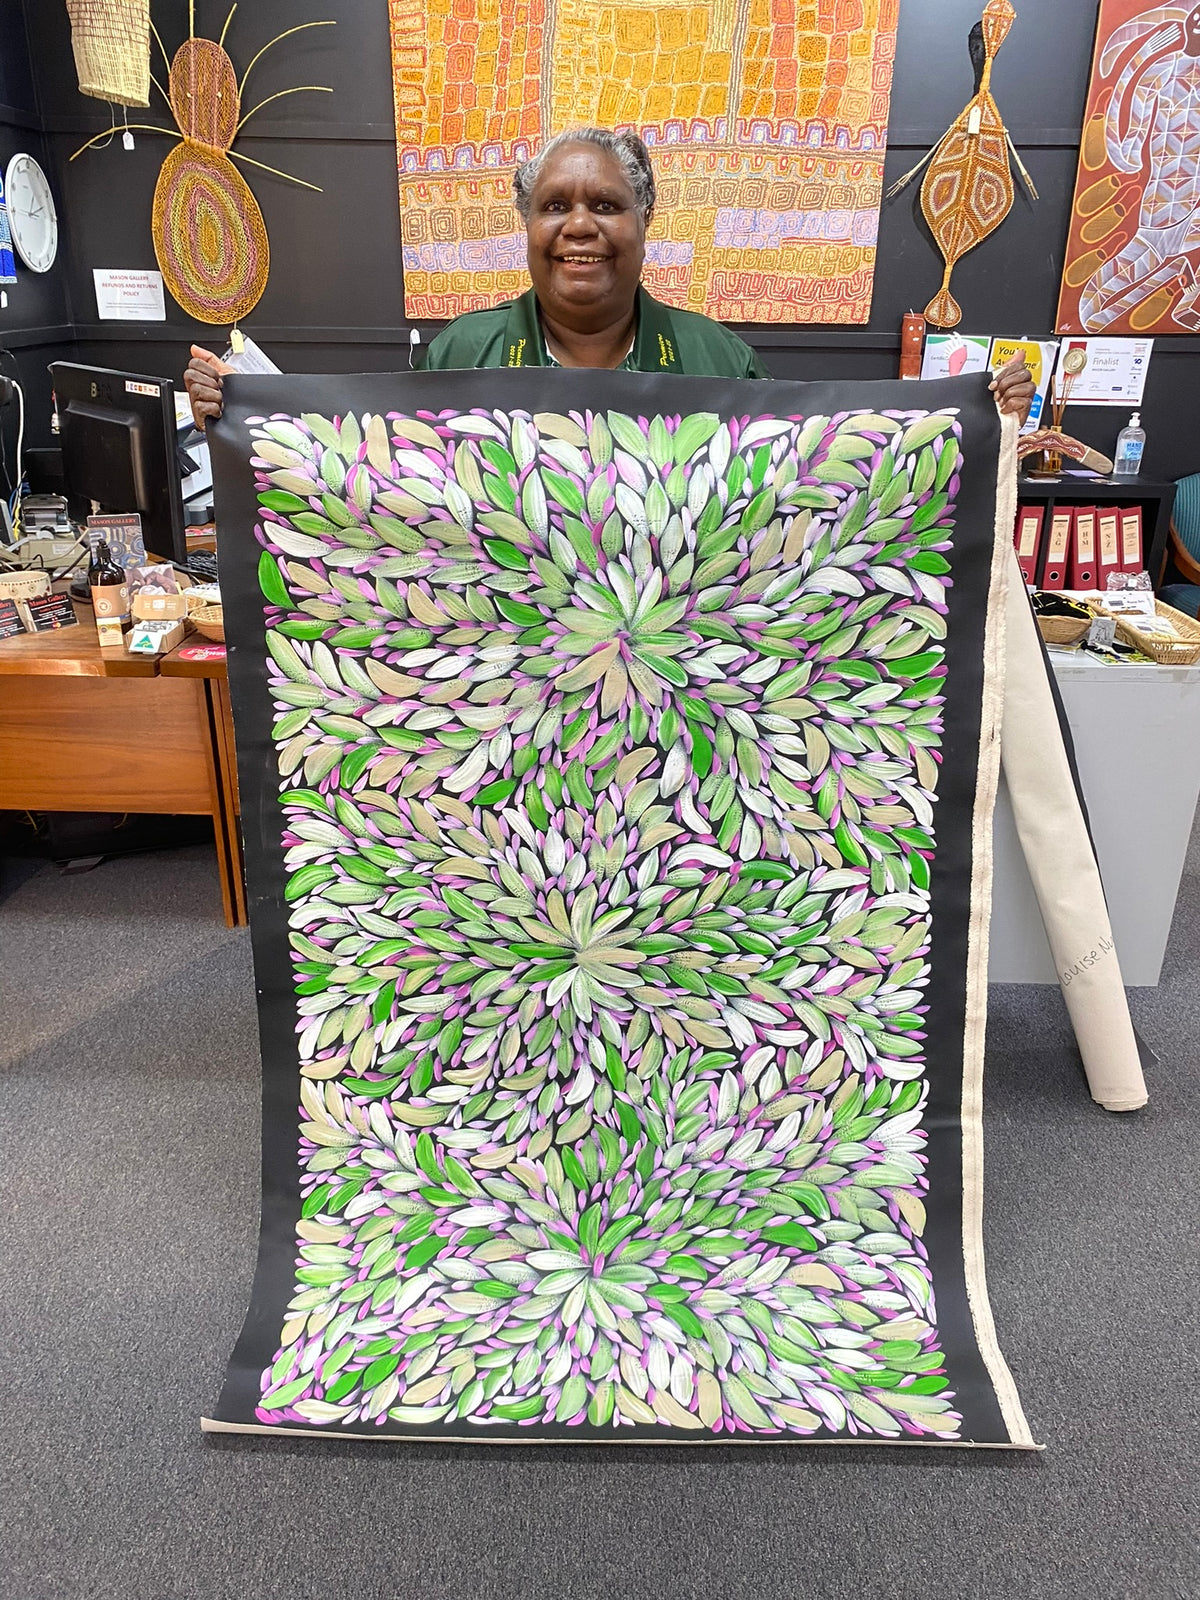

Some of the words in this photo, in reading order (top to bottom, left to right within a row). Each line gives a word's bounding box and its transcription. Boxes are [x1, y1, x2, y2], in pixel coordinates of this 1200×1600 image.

[1093, 357, 1120, 366] Finalist
[47, 594, 67, 603] Gallery
[1059, 950, 1101, 987] Louise
